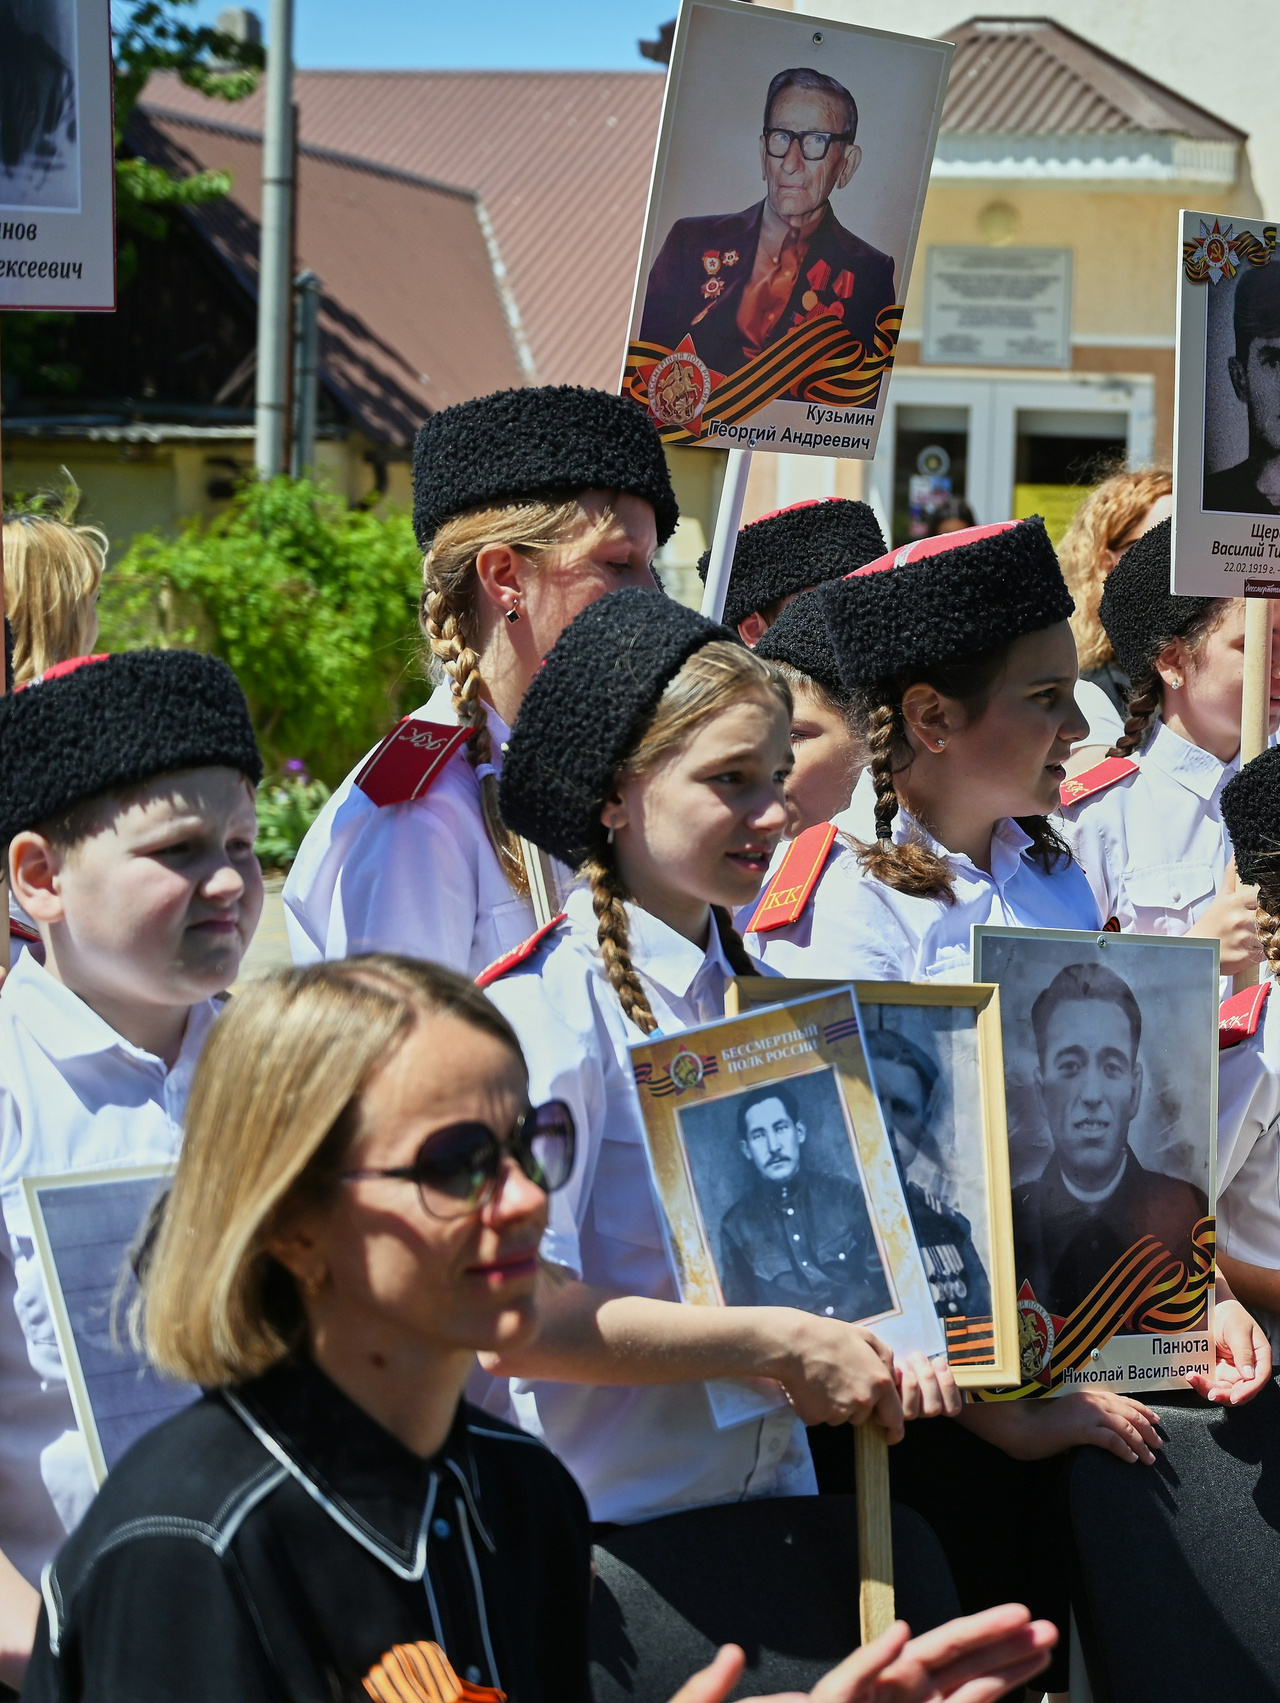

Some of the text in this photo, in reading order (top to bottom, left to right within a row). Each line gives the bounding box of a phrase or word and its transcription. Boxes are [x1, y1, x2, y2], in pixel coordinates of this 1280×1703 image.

[0, 222, 38, 240] нов
[686, 353, 704, 368] ПОЛК
[701, 369, 711, 405] РОССИИ
[806, 404, 876, 428] Кузьмин
[708, 419, 871, 450] Георгий Андреевич
[1211, 541, 1265, 558] Василий
[1224, 562, 1268, 575] 22.02.1919
[721, 1023, 819, 1061] БЕССМЕРТНЫЙ
[727, 1053, 765, 1075] ПОЛК
[765, 1040, 819, 1064] РОССИИ
[1152, 1337, 1210, 1356] Панюта
[1063, 1363, 1210, 1385] Николай Васильевич
